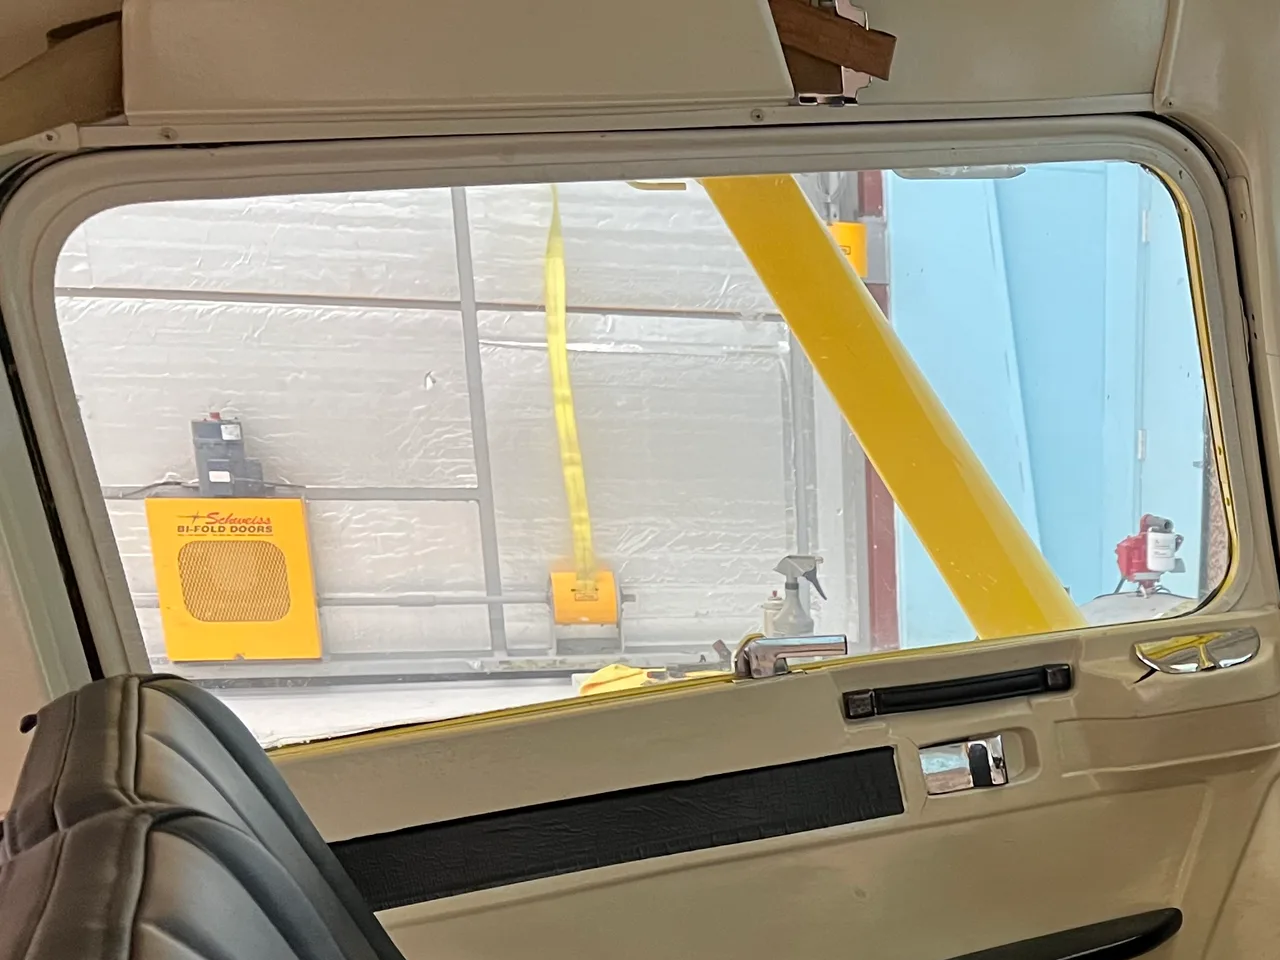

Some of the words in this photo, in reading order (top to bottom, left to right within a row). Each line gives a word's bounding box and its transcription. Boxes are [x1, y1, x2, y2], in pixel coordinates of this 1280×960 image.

[205, 511, 272, 525] Schweiss
[177, 525, 226, 533] BI-FOLD
[230, 525, 273, 533] DOORS
